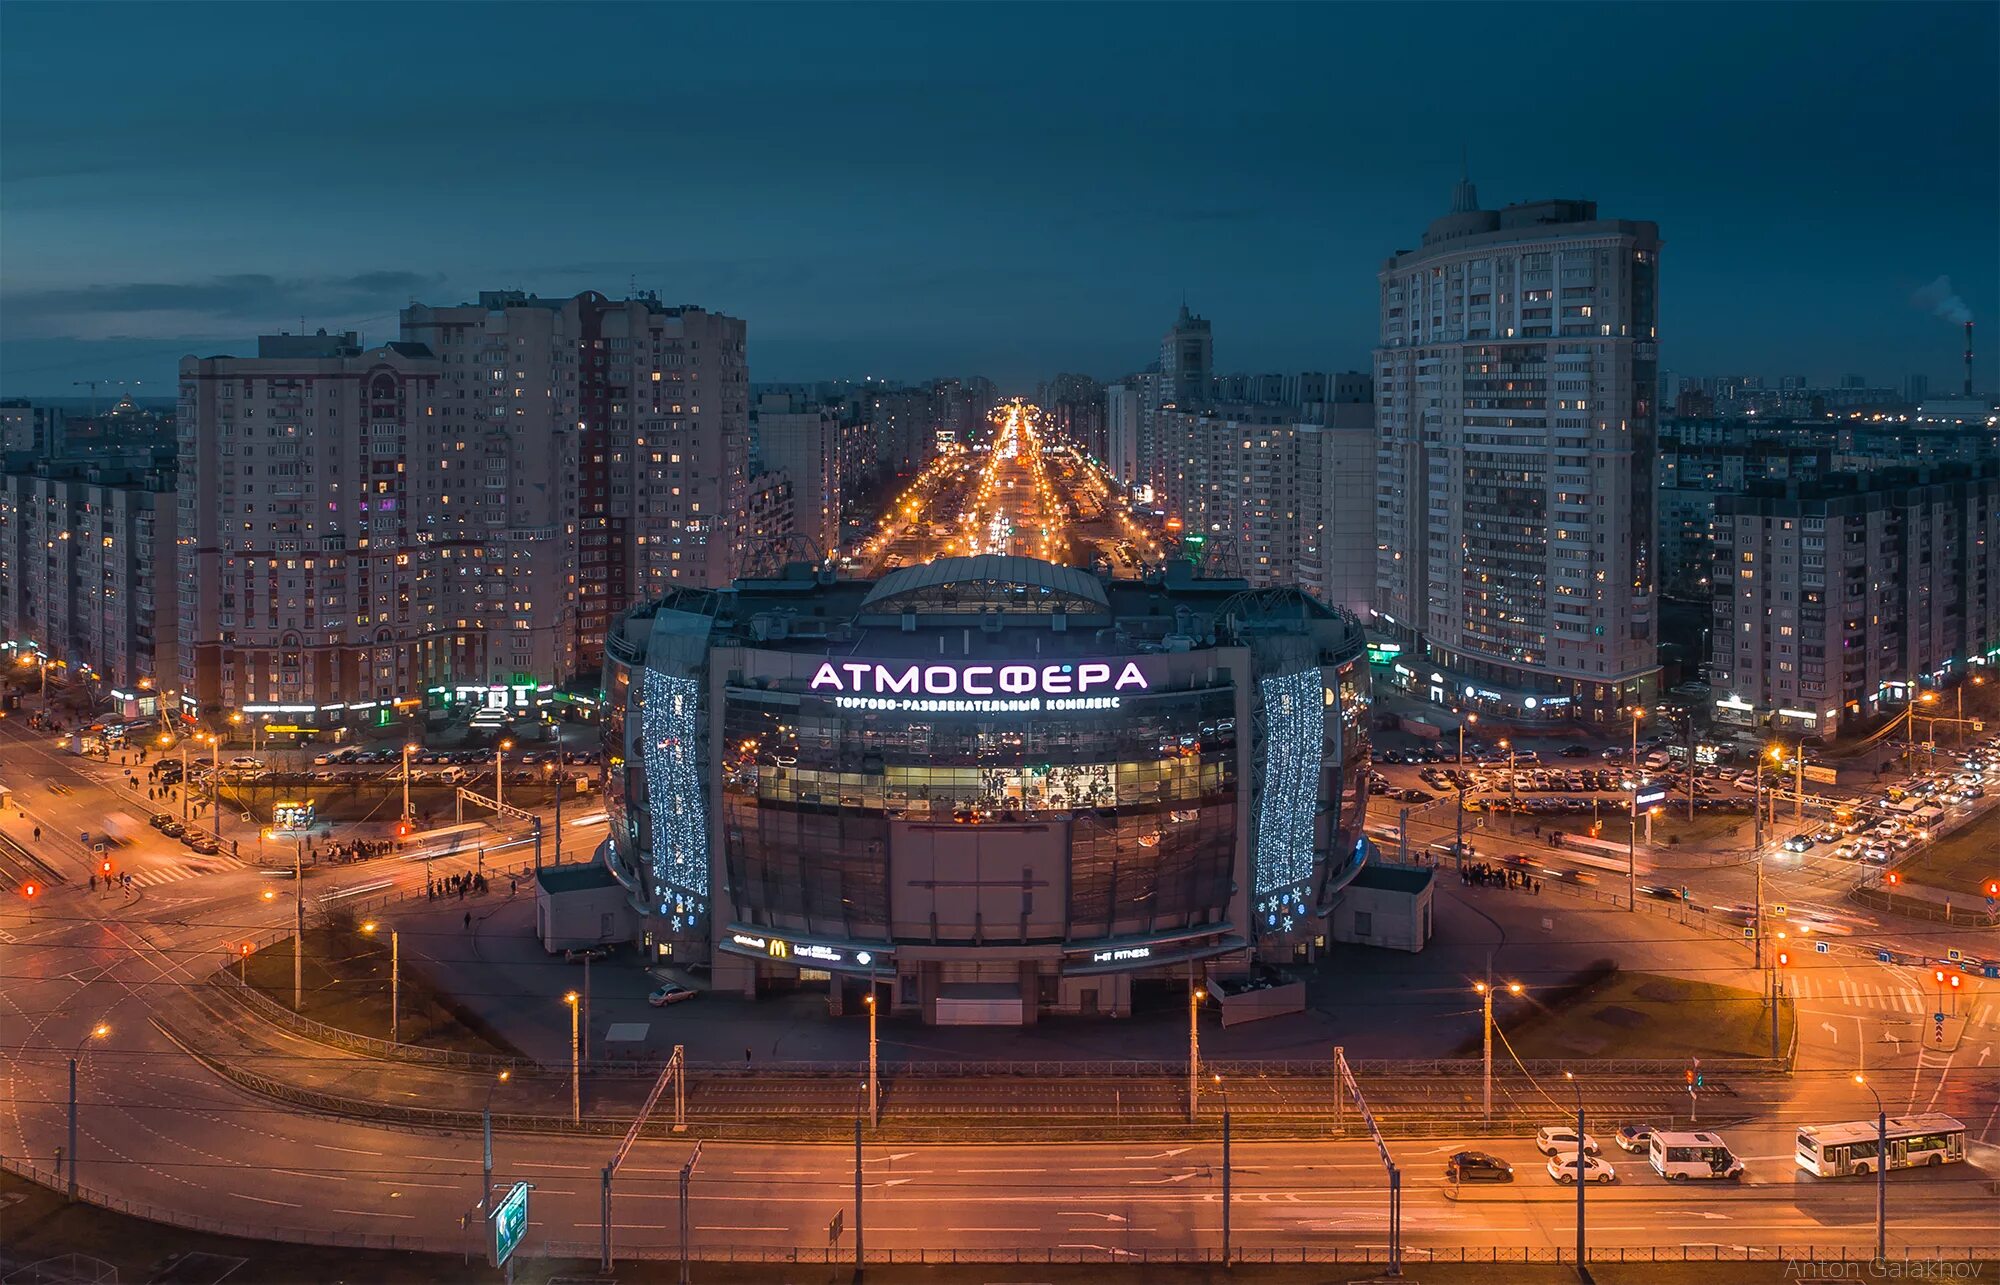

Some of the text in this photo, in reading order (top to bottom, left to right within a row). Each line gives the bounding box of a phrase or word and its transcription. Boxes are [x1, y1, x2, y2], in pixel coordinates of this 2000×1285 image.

[811, 662, 1148, 695] АТМОСФЕРА
[835, 697, 1120, 712] ТОРГОВО-РАЗВЛЕКАТЕЛЬНЫЙ КОМПЛЕКС
[1114, 948, 1150, 960] FITNESS
